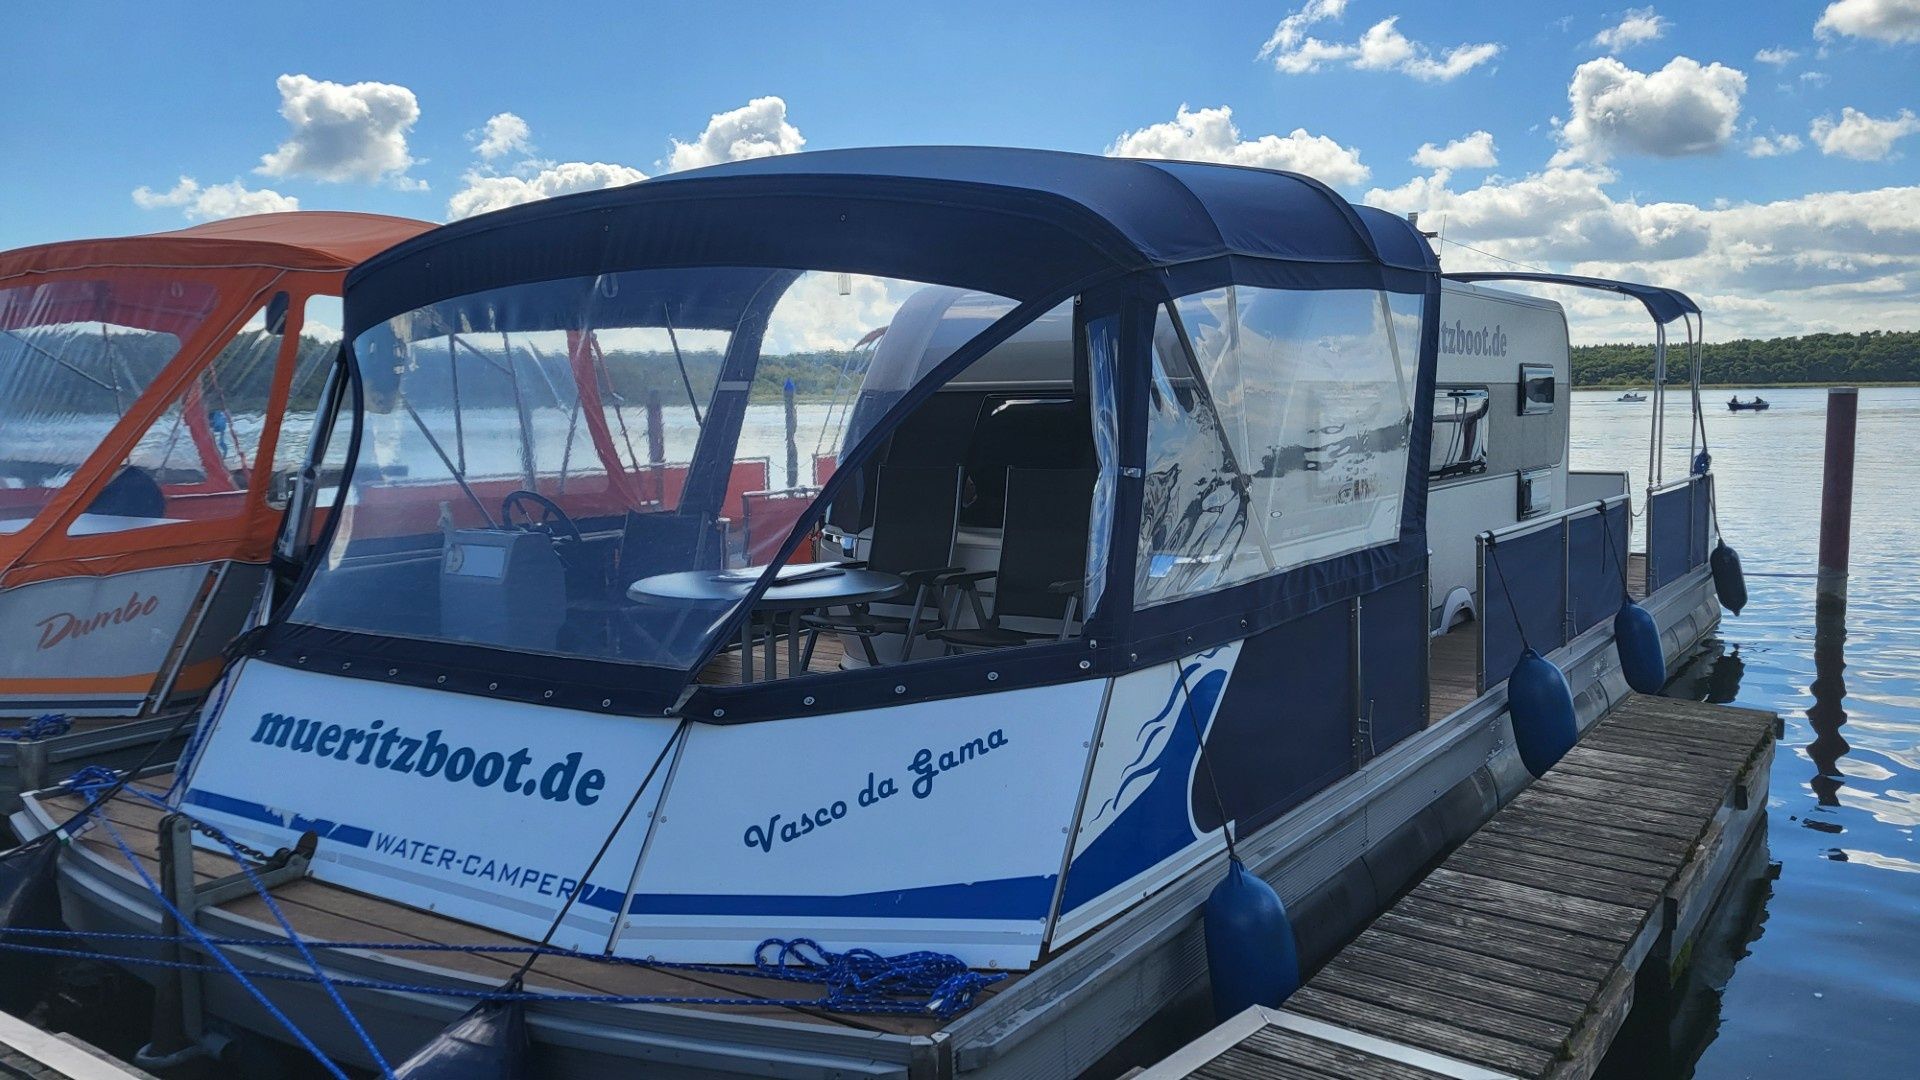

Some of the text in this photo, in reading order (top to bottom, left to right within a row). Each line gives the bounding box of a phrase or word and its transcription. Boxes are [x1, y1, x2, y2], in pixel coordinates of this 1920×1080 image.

[1438, 319, 1507, 357] tzboot.de
[36, 591, 158, 651] Dumbo
[250, 712, 606, 806] mueritzboot.de
[743, 728, 1009, 853] Vasco da Gama
[374, 832, 578, 899] WATER-CAMPER
